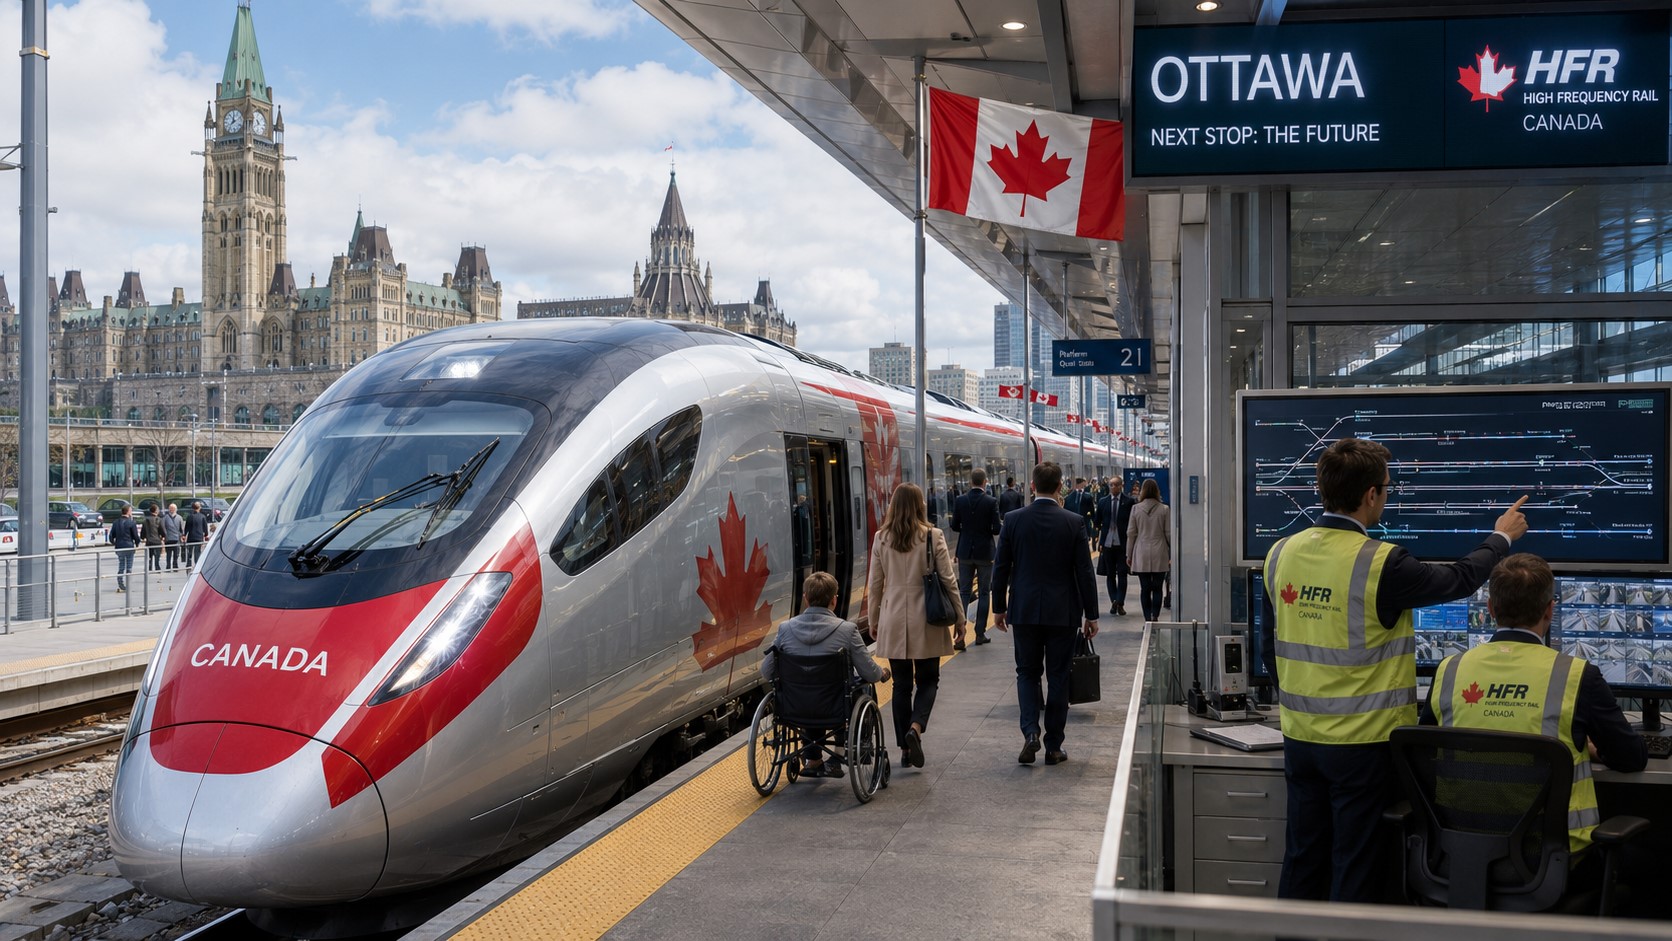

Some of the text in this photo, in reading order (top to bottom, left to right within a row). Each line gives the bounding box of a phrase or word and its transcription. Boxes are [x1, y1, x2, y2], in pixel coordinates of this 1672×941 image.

[1524, 48, 1620, 85] HFR
[1151, 51, 1365, 103] OTTAWA
[1523, 89, 1659, 105] HIGH FREQUENCY RAIL
[1523, 112, 1604, 132] CANADA
[1151, 123, 1380, 146] NEXT STOP: THE FUTURE
[1120, 347, 1142, 367] 21
[1299, 585, 1332, 603] HFR
[190, 642, 328, 677] CANADA
[1486, 683, 1529, 699] HFR
[1483, 709, 1515, 718] CANADA
